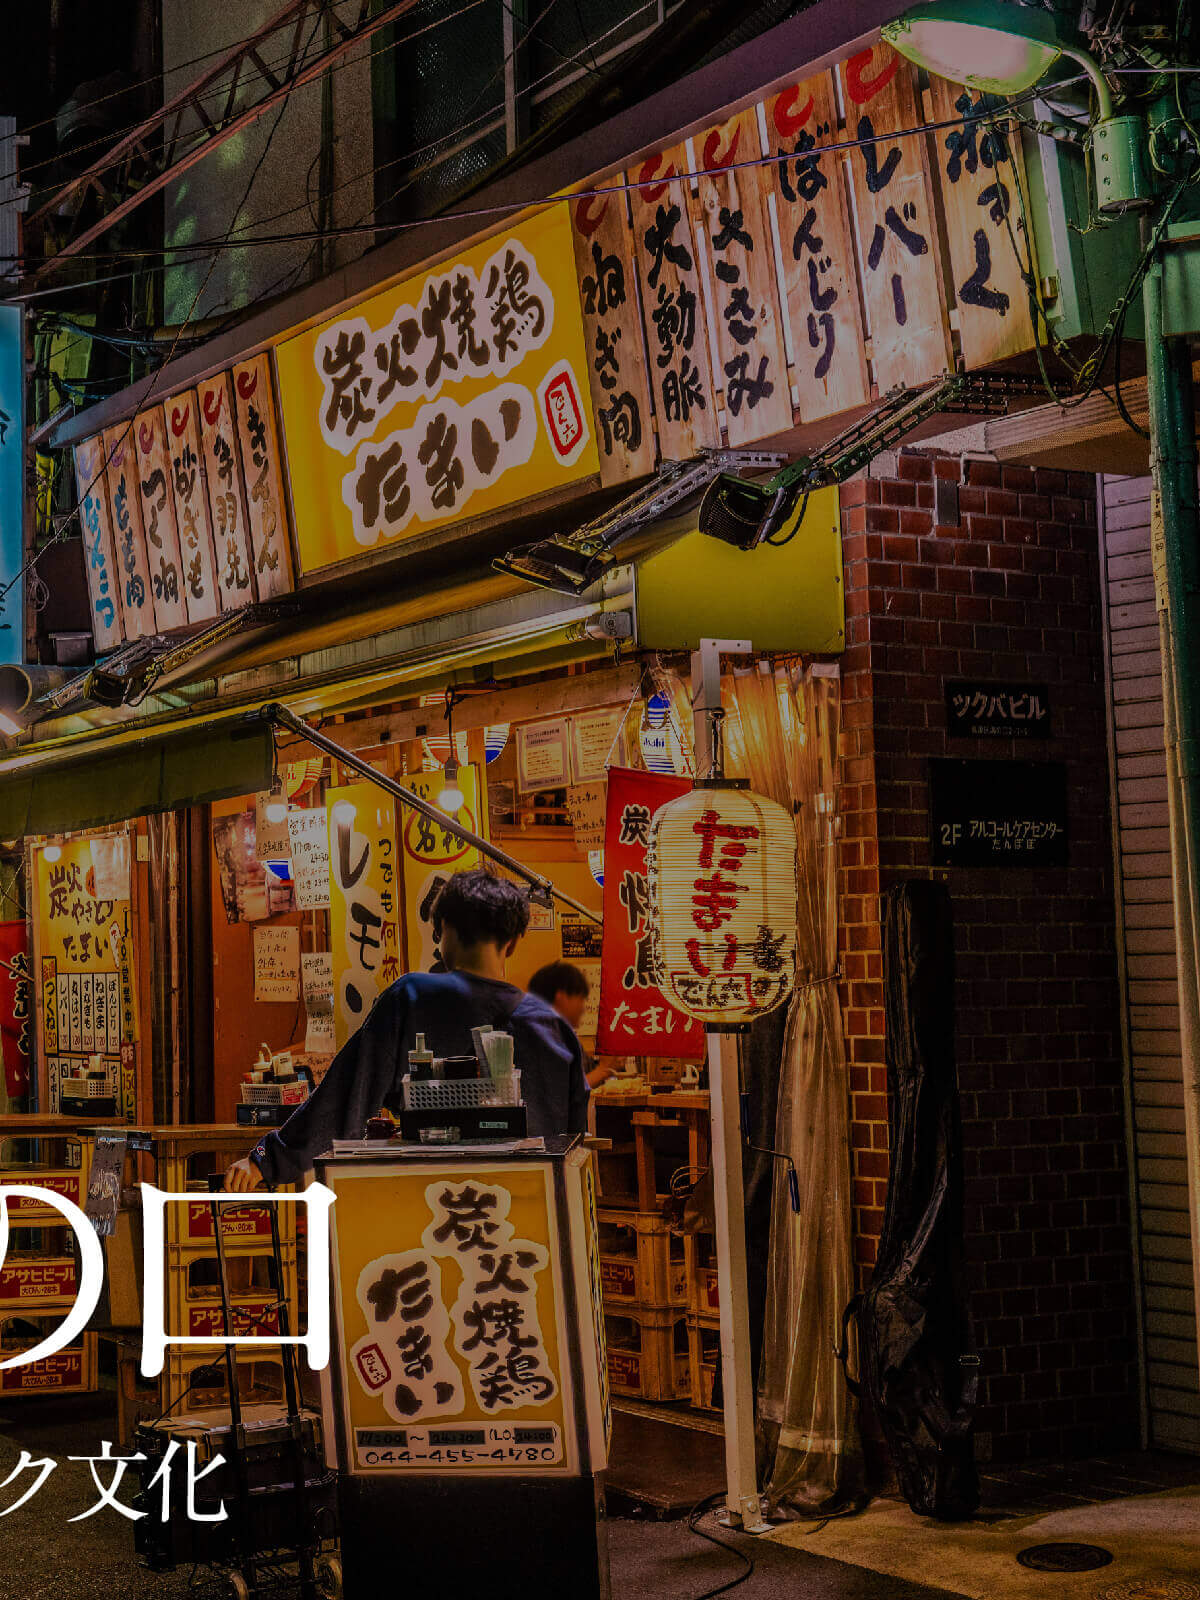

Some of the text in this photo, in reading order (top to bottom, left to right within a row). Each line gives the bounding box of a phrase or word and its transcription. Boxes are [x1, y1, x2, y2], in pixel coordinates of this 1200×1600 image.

[857, 117, 928, 325] レバー
[324, 250, 545, 436] 炭火焼鶏
[582, 242, 641, 454] ねぎ間
[645, 205, 705, 422] 大動脈
[712, 207, 774, 416] ささみ
[142, 468, 178, 603] つくね
[357, 399, 520, 527] たまい
[952, 692, 1049, 720] ツクバビル
[686, 809, 760, 977] たまい
[940, 824, 962, 846] 2F
[1, 1267, 76, 1283] アサヒビール
[367, 1260, 454, 1415] たまい
[434, 1185, 553, 1408] 炭火焼鶏
